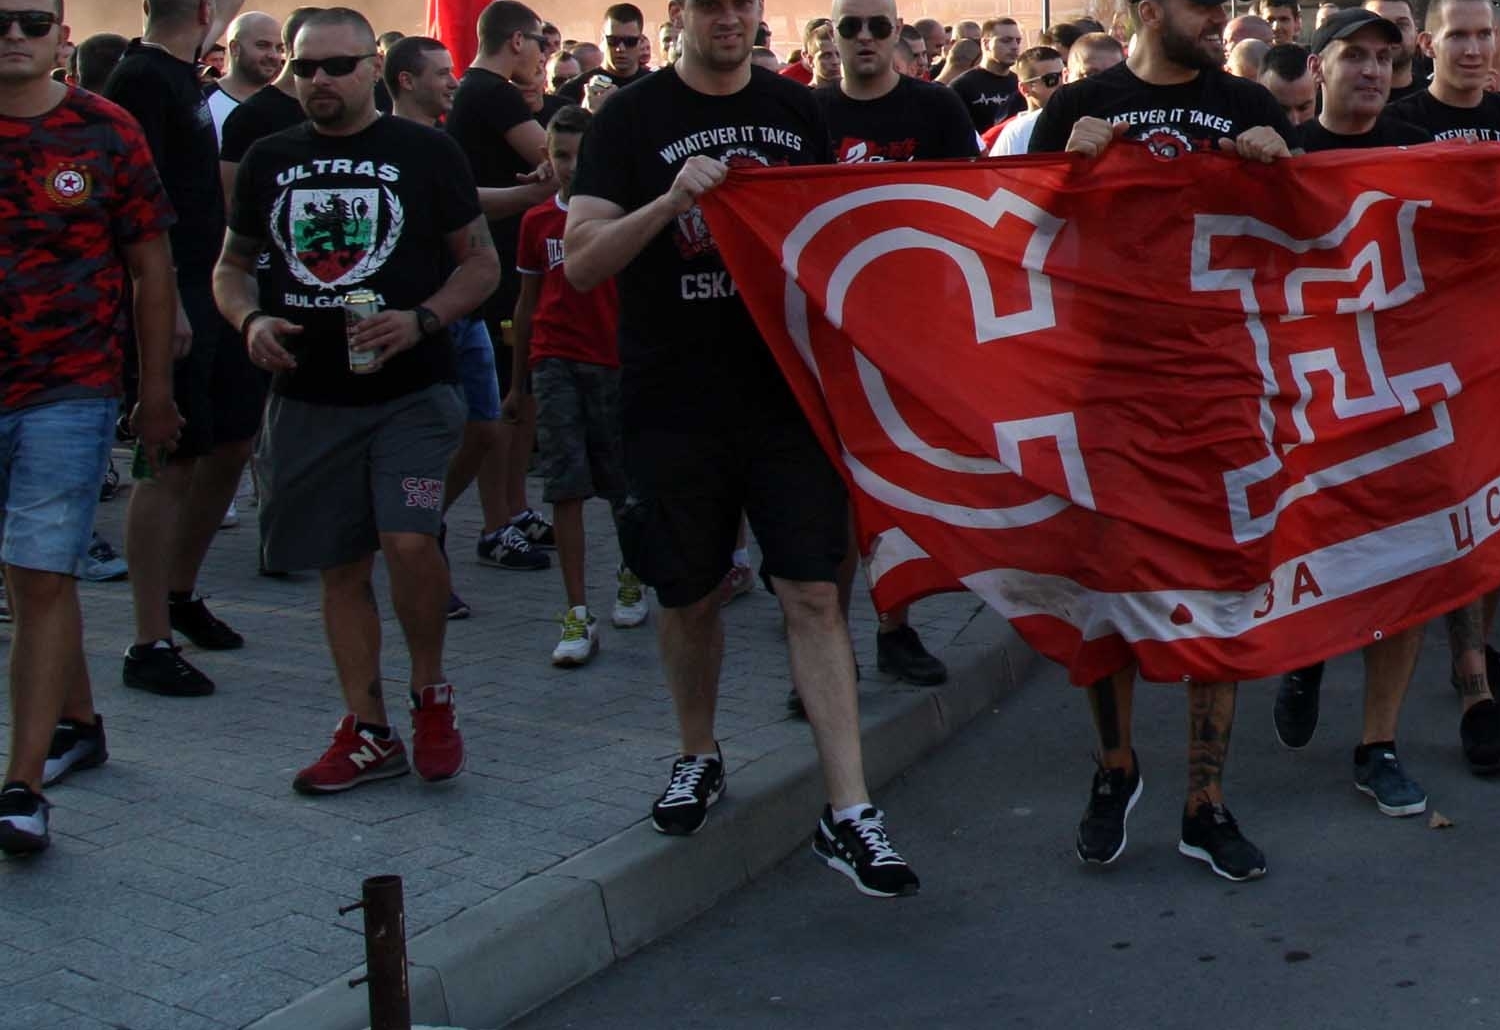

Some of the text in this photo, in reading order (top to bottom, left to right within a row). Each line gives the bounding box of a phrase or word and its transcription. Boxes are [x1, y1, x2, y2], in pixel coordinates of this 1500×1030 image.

[1170, 108, 1184, 122] IT
[1189, 110, 1233, 133] TAKES
[660, 126, 802, 165] WHATEVER IT TAKES
[1480, 129, 1491, 141] IT
[276, 158, 400, 186] ULTRAS
[285, 293, 386, 307] BULGAA
